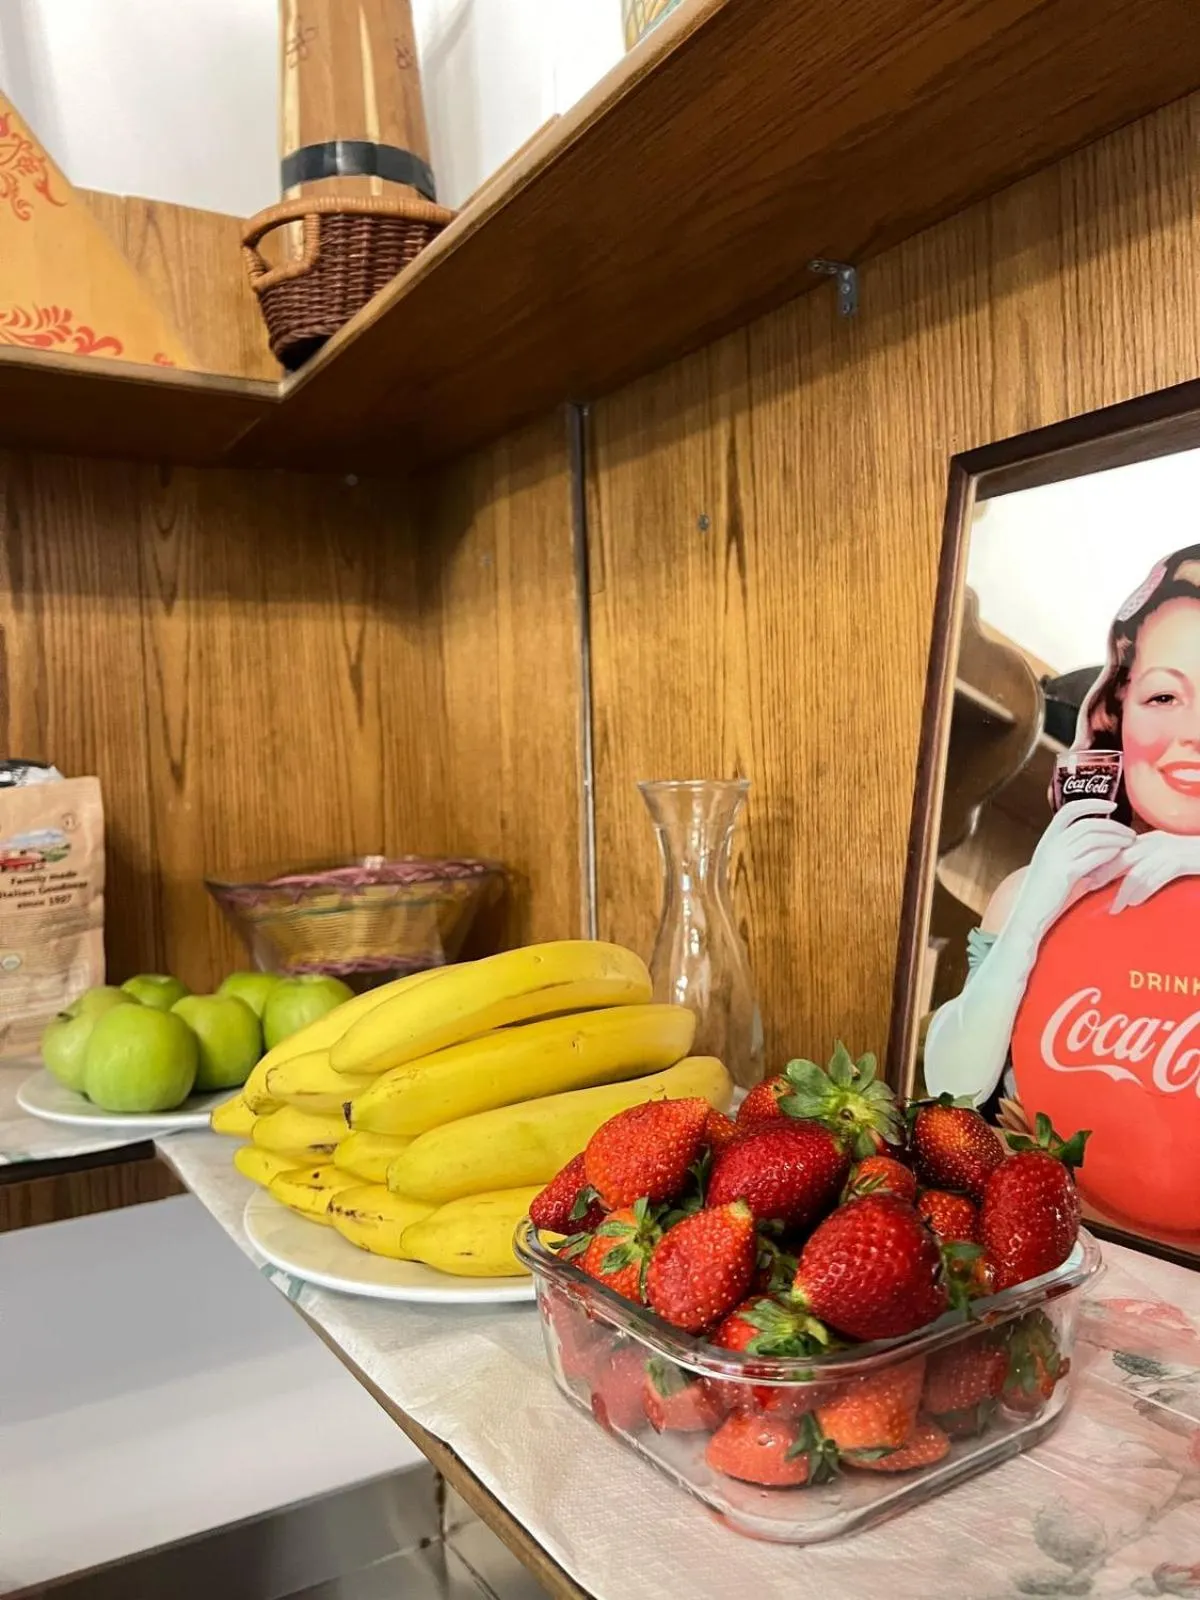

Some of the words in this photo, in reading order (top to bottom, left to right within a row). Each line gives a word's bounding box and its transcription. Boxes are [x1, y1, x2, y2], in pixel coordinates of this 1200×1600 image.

[10, 876, 46, 888] Family
[49, 870, 77, 880] made
[1040, 986, 1200, 1099] Coca-C
